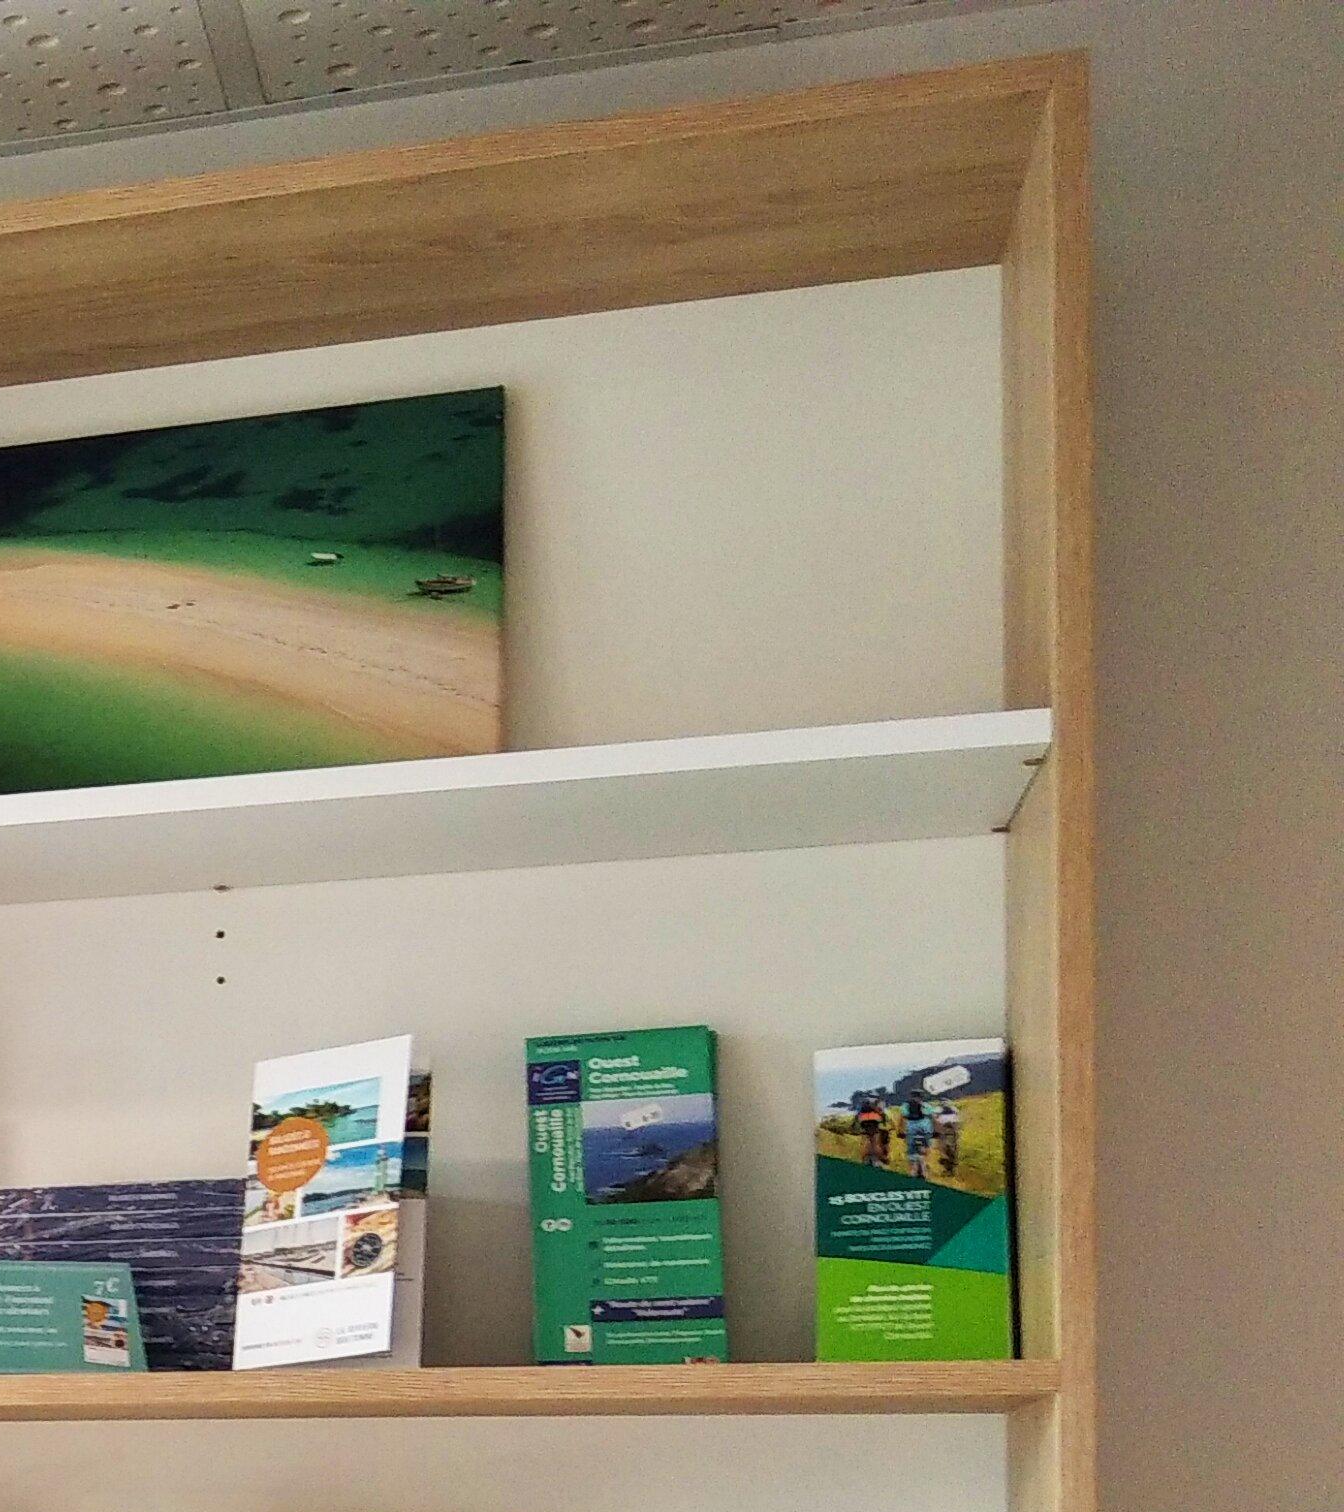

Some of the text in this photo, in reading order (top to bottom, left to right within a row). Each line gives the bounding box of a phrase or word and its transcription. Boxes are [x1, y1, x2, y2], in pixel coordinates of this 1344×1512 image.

[588, 1055, 640, 1069] Ouest
[588, 1066, 689, 1084] Cornouaille
[533, 1109, 549, 1153] Ouest
